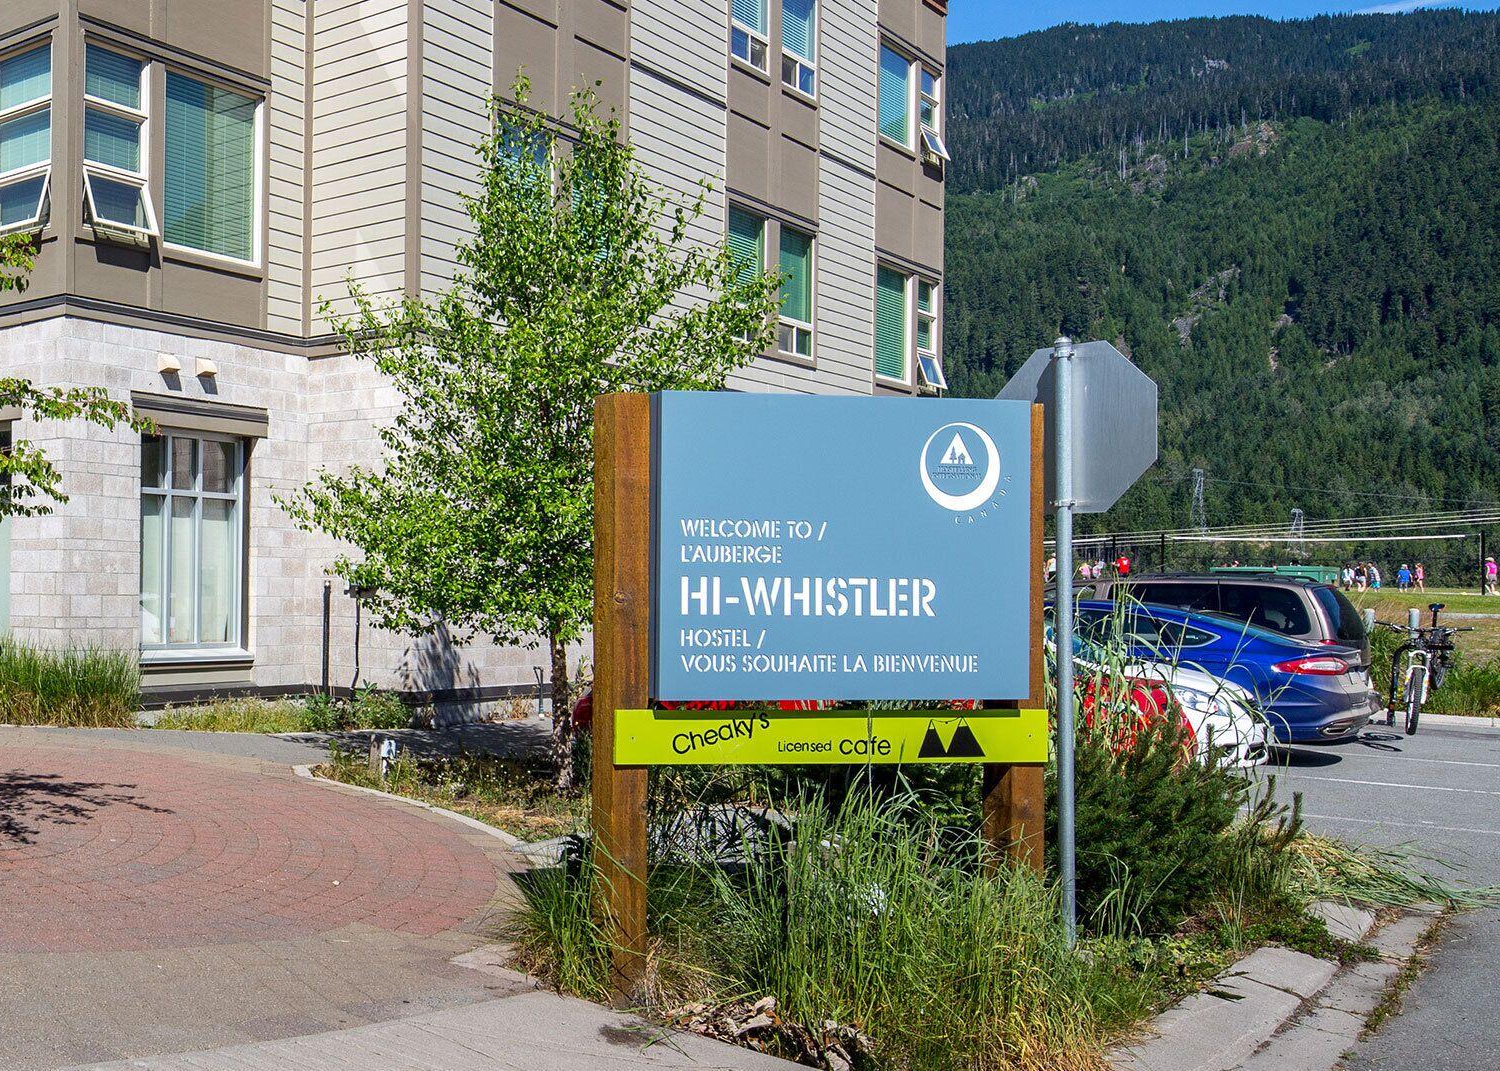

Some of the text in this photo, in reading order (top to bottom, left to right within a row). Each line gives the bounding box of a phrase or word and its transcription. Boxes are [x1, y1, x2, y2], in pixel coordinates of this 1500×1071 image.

[681, 520, 780, 538] WELCOME
[787, 520, 812, 538] TO
[681, 545, 782, 564] L'AUBERGE
[681, 576, 937, 617] HI-WHISTLER
[681, 629, 751, 647] HOSTEL
[681, 654, 979, 673] VOUS SOUHAITE LA BIENVENUE
[672, 712, 892, 756] Cheaky's Licensed cafe
